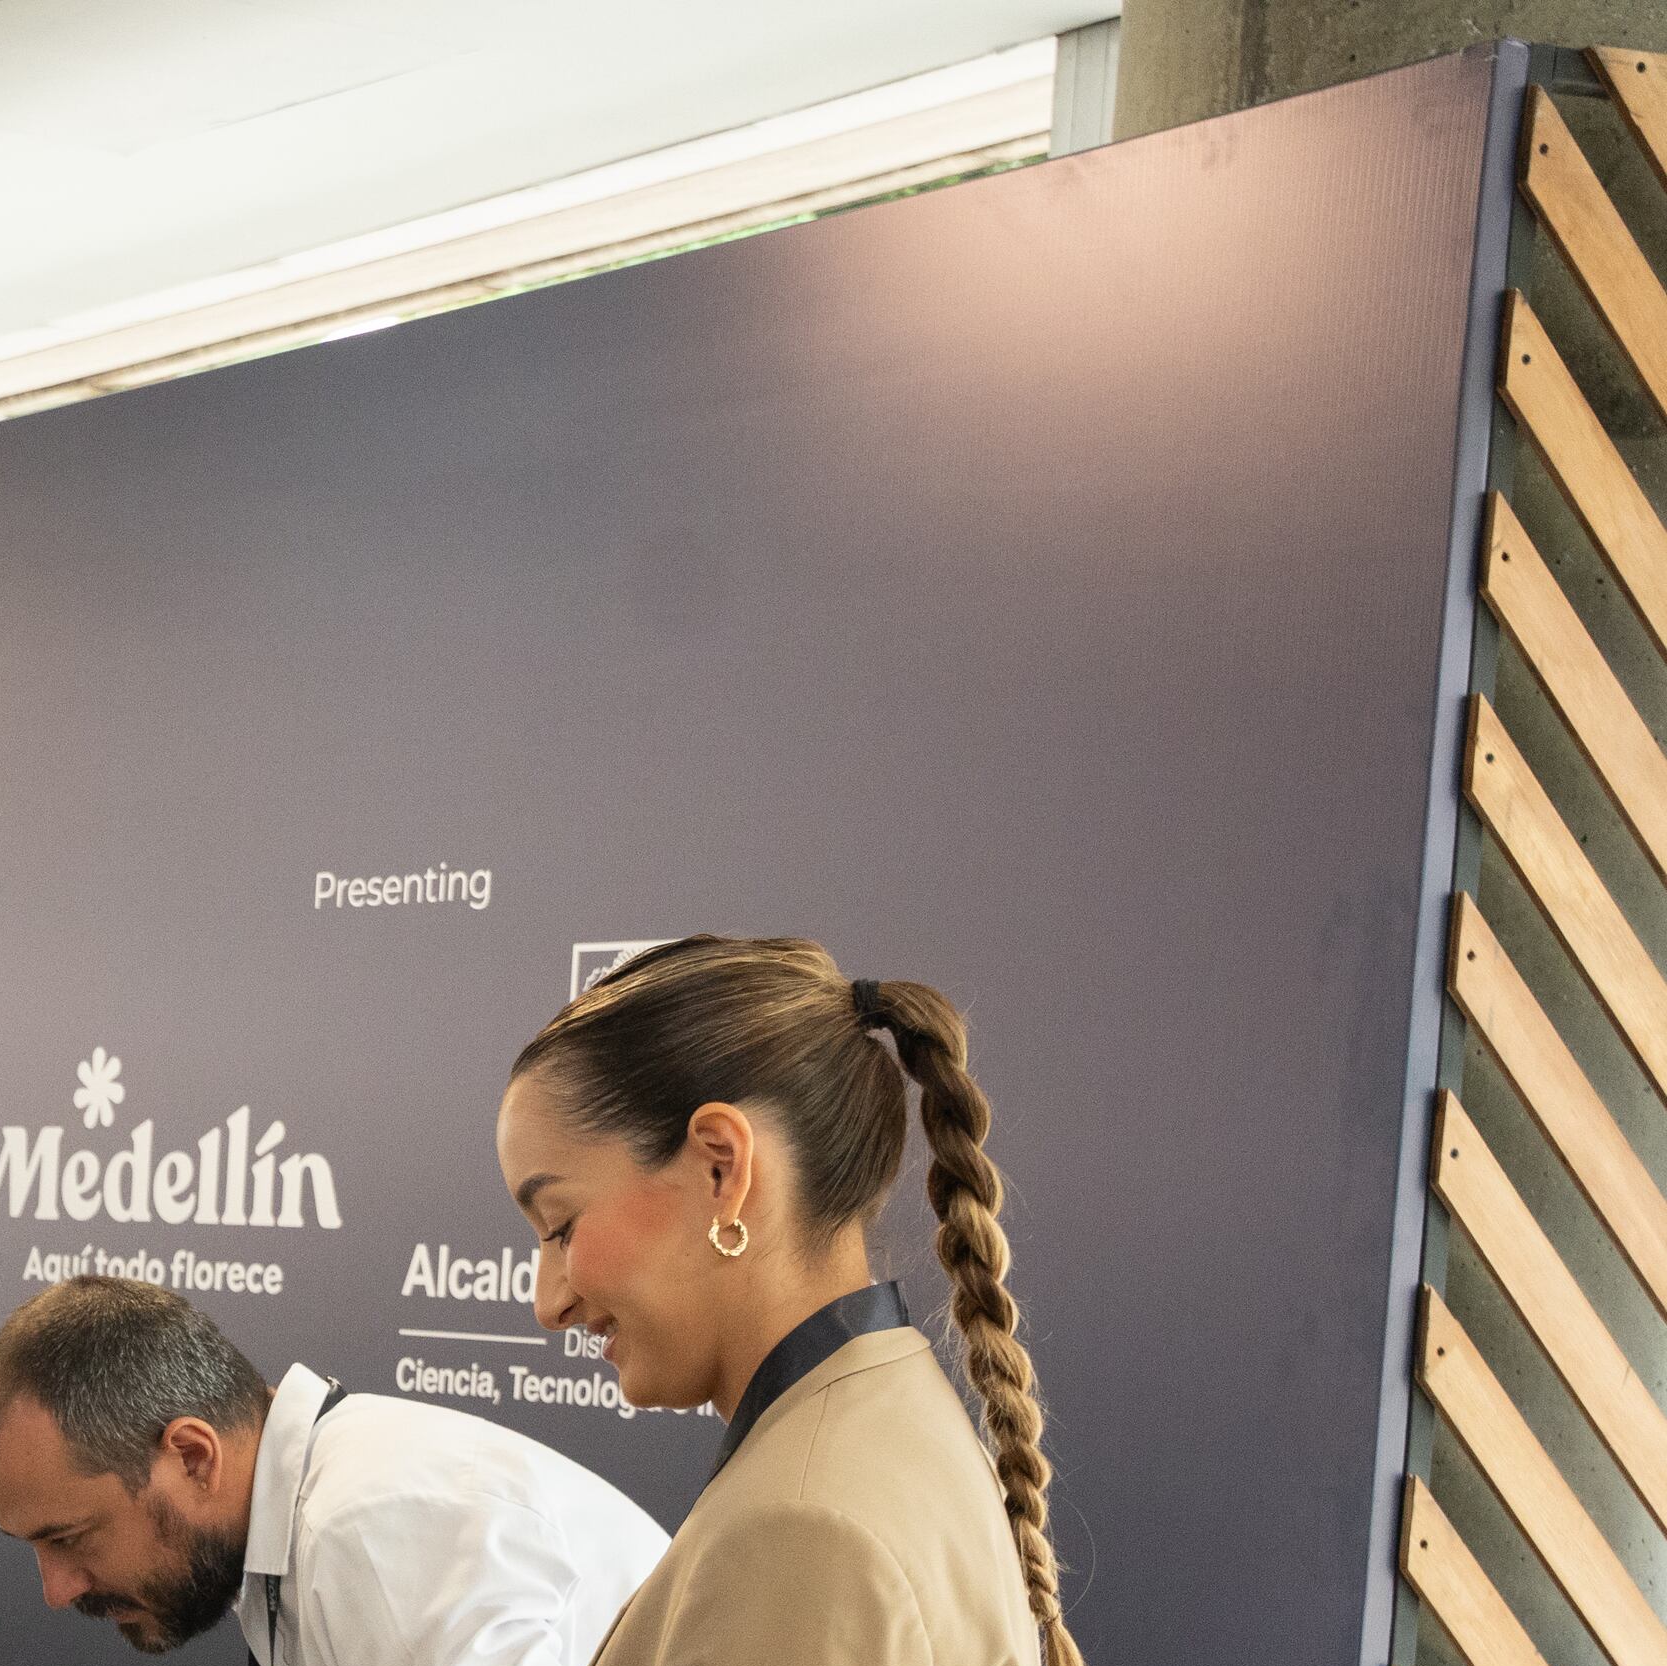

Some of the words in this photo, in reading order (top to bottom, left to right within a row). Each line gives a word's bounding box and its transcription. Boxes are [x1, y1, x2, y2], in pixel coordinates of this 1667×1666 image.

[314, 861, 492, 910] Presenting
[95, 1248, 166, 1285] todo
[170, 1249, 284, 1295] florece
[395, 1357, 501, 1405] Ciencia,
